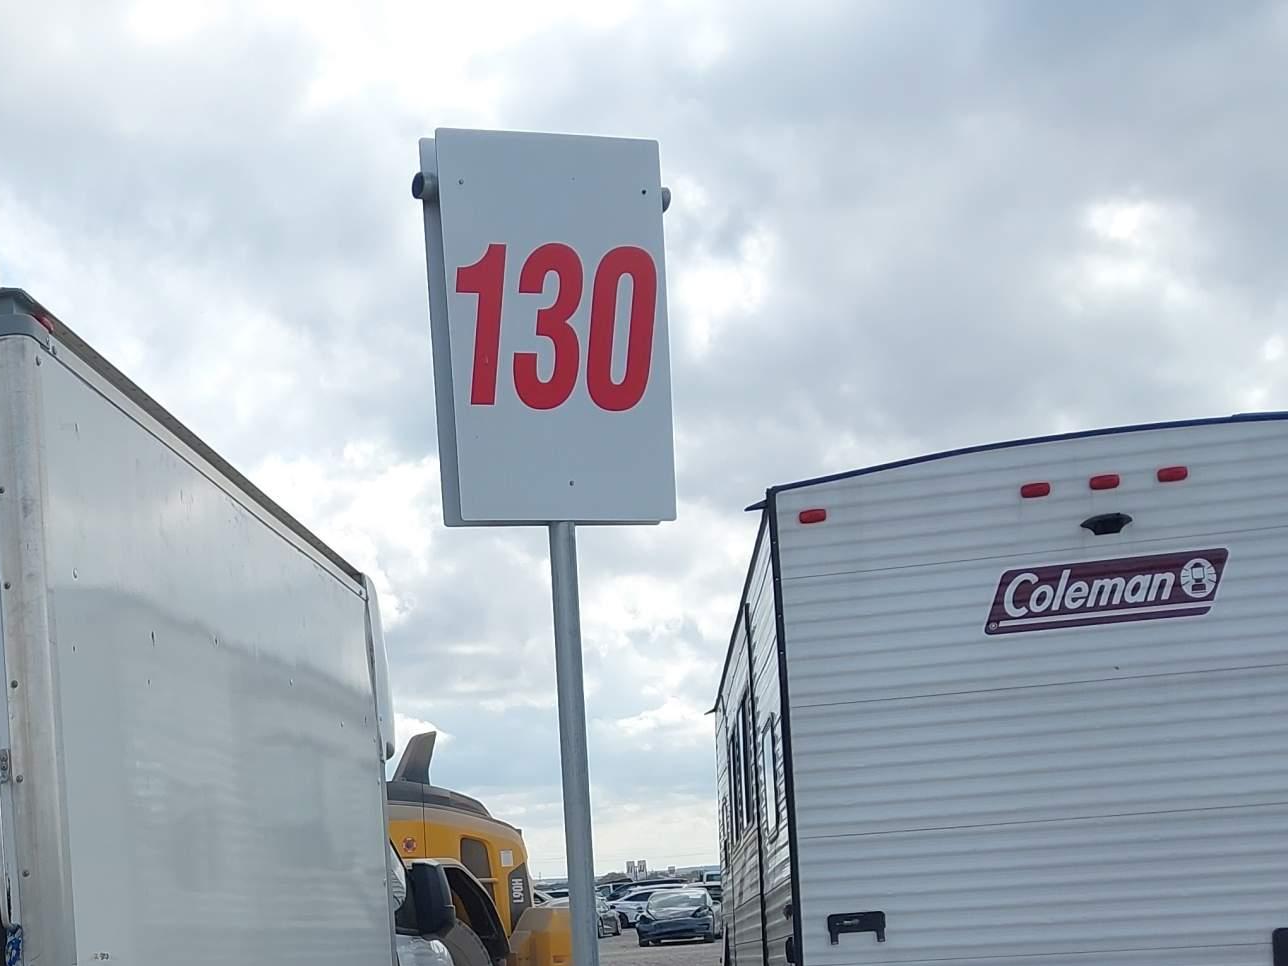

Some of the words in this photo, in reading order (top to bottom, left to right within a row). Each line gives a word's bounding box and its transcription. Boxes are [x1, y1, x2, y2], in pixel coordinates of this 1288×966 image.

[456, 242, 657, 412] 130
[1004, 569, 1175, 618] Coleman
[512, 878, 524, 903] L90H
